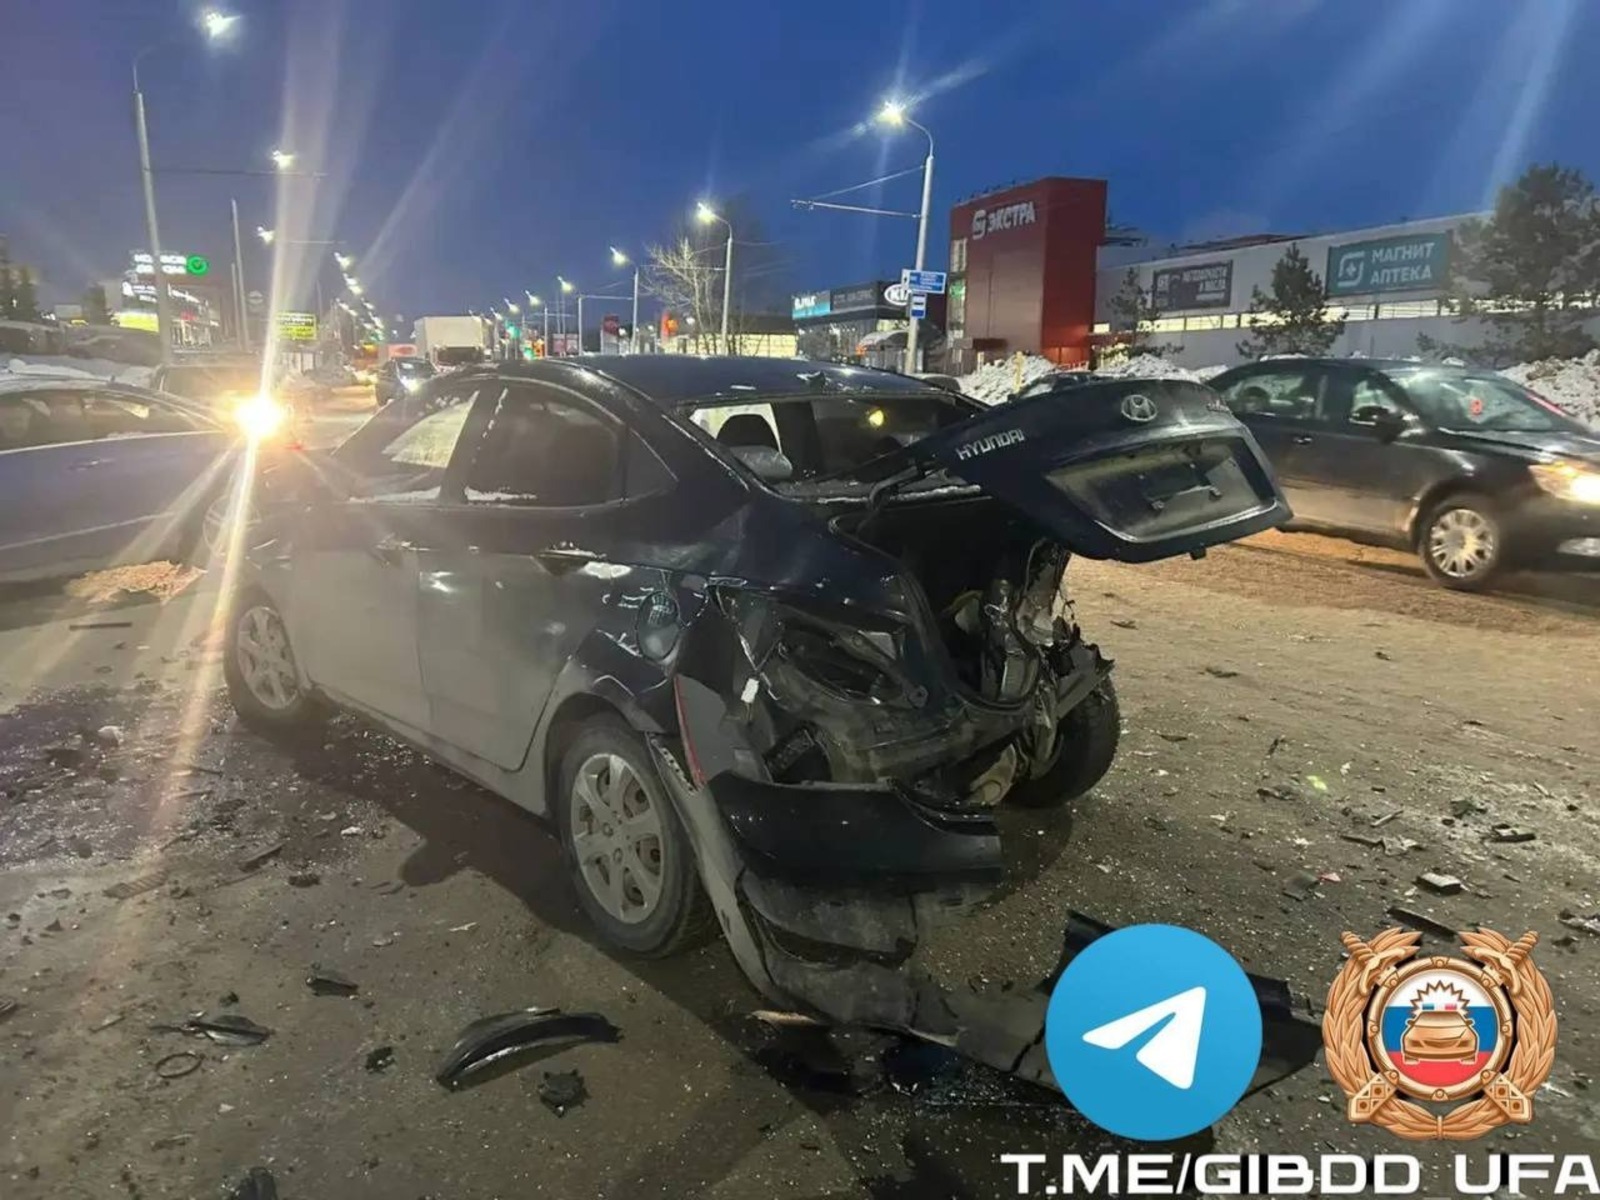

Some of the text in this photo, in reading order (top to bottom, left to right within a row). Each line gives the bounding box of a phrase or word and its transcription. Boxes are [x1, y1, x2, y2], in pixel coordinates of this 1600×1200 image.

[987, 201, 1036, 233] ЭКСТРА
[1371, 242, 1435, 264] МАГНИТ
[1370, 264, 1432, 285] АПТЕКА
[955, 428, 1026, 461] HYUNDAI
